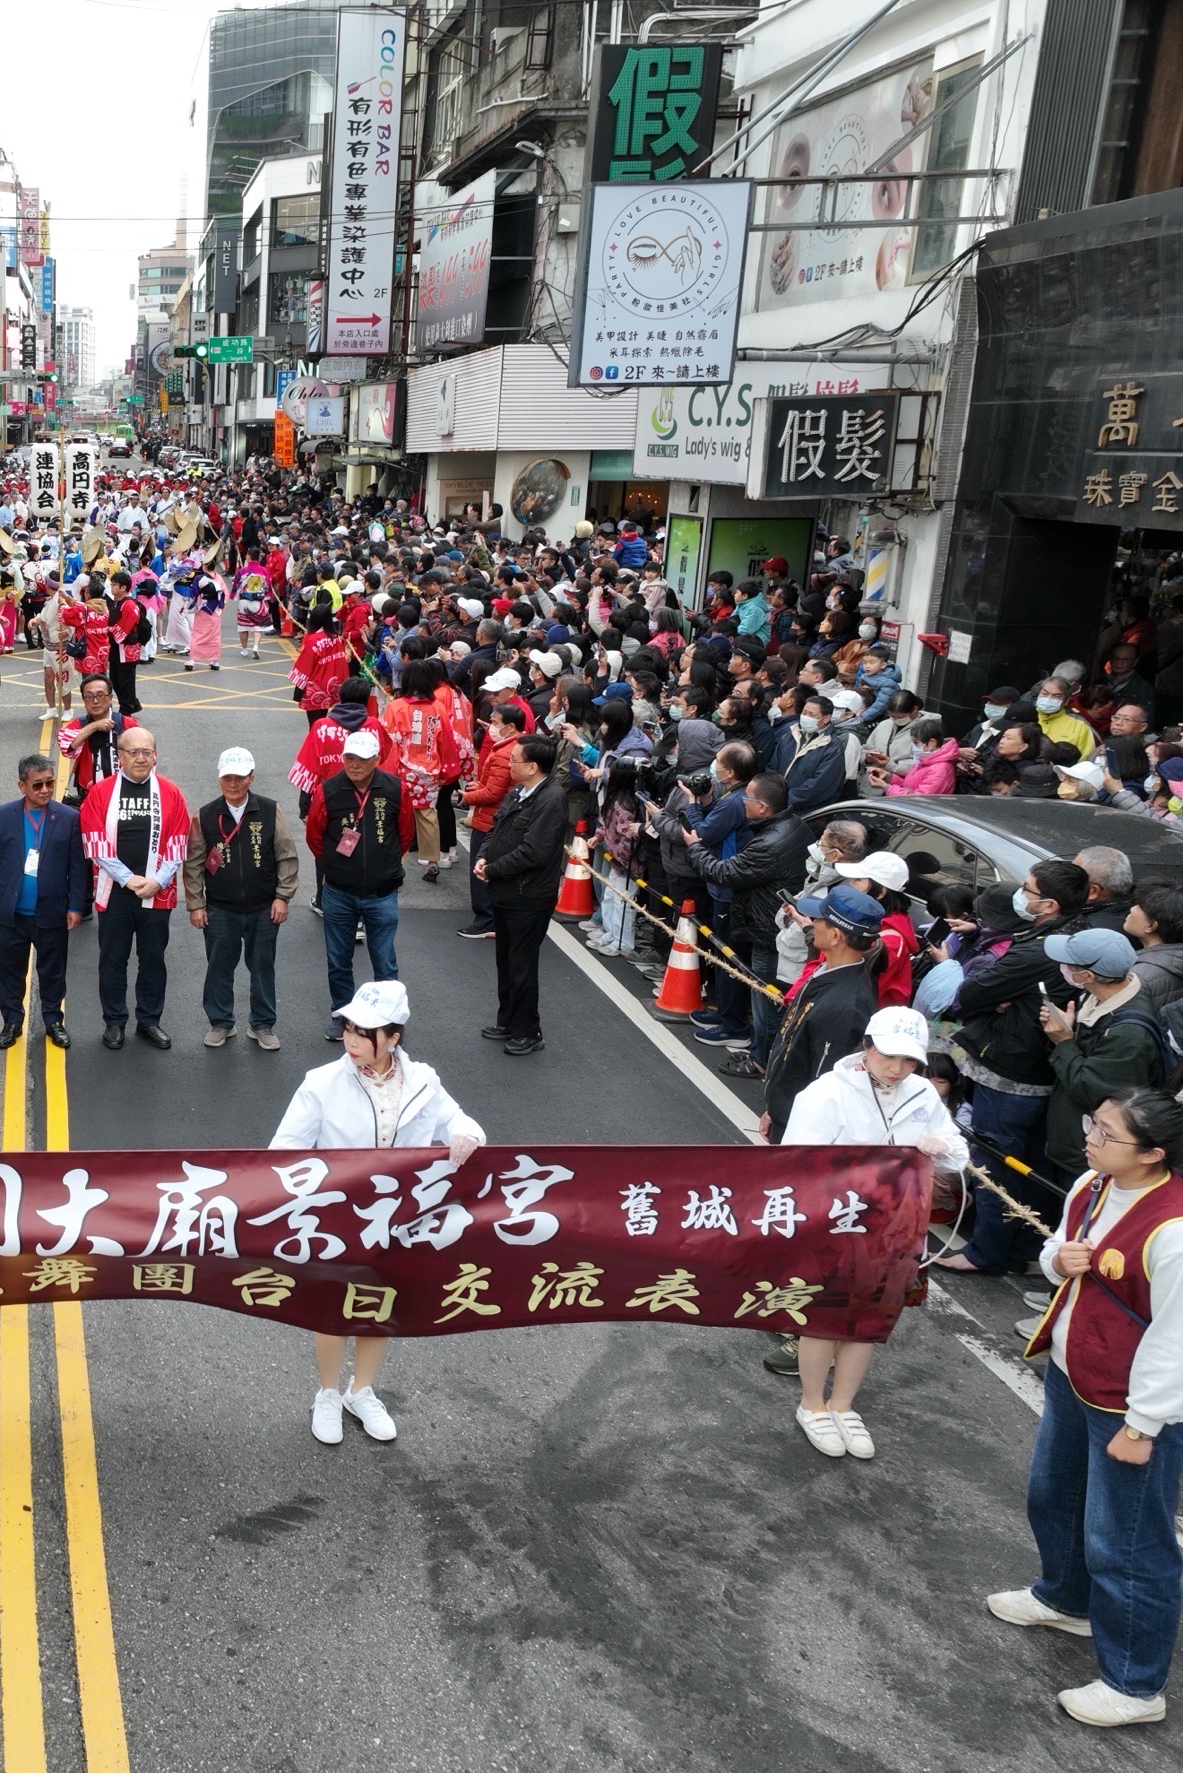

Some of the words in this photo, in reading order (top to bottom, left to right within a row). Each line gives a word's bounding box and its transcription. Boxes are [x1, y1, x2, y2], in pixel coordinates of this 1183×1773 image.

[377, 28, 396, 116] COLOR
[608, 46, 705, 181] 假
[374, 124, 392, 176] BAR
[338, 97, 373, 300] 有形有色專業染護中心
[613, 205, 642, 238] LOVE
[651, 194, 719, 233] BEAUTIFUL
[222, 240, 231, 277] NET
[608, 255, 628, 298] PARTY
[696, 254, 722, 296] GIRLS
[373, 288, 388, 299] 2F
[222, 338, 248, 347] 成功路
[333, 339, 384, 349] 於旁邊巷子內
[337, 329, 379, 339] 本店入口處
[624, 366, 647, 380] 2F
[685, 436, 717, 460] Lady's
[720, 440, 741, 463] wig
[778, 408, 887, 484] 假髮
[36, 451, 55, 509] 連協会
[71, 451, 91, 510] 高円寺
[618, 1181, 869, 1237] 舊城再生
